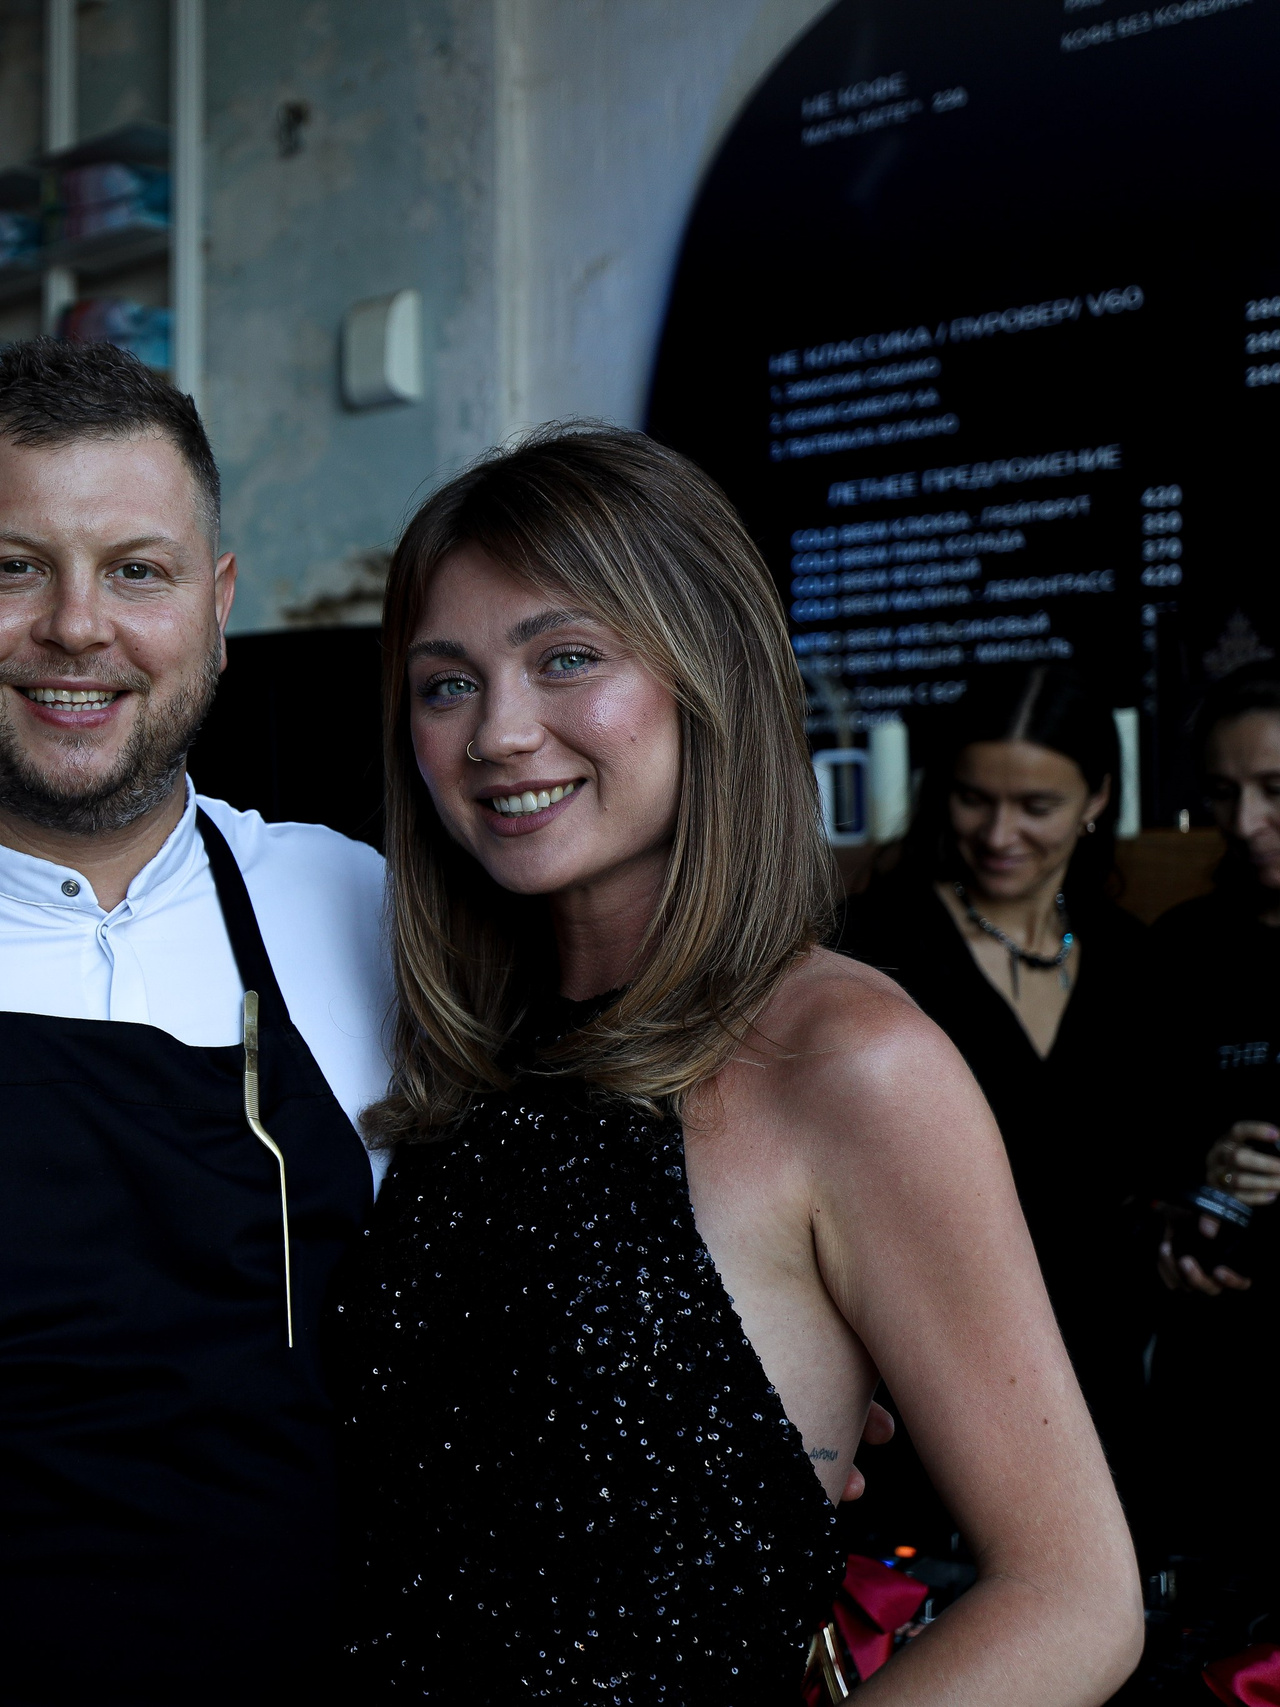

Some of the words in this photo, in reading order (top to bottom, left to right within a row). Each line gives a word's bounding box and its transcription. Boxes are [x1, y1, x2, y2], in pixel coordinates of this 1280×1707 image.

[768, 349, 801, 378] НЕ
[802, 324, 933, 371] КЛАССИКА
[1085, 284, 1145, 318] V60
[826, 469, 919, 509] ЛЕТНЕЕ
[920, 443, 1123, 495] ПРЕДЛОЖЕНИЕ
[1218, 1042, 1269, 1069] THE
